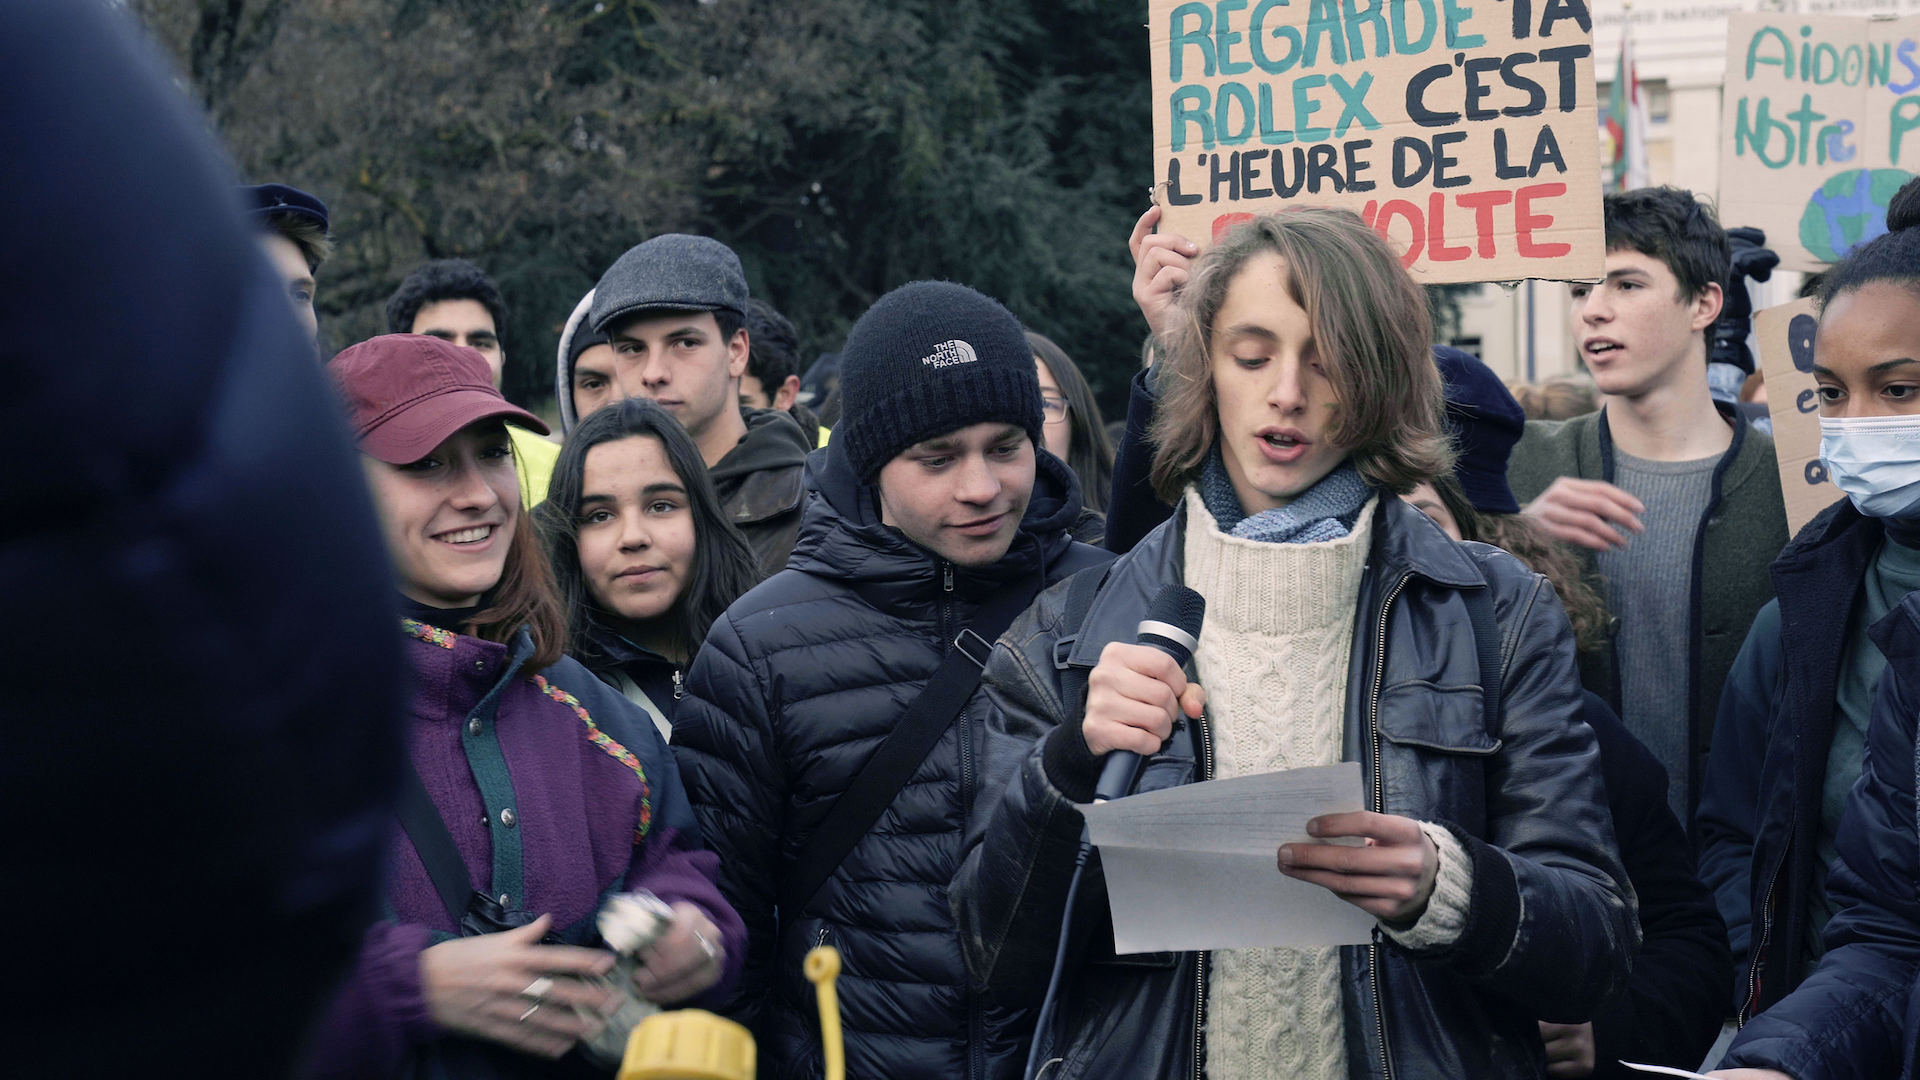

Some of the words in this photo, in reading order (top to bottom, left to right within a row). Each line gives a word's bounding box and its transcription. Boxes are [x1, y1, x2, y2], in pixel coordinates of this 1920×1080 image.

[1170, 0, 1487, 83] REGARDE
[1170, 71, 1384, 152] ROLEX
[1406, 44, 1591, 127] C'EST
[1168, 139, 1375, 206] L'HEURE
[1393, 131, 1472, 189] DE
[1494, 124, 1568, 179] LA
[921, 349, 957, 365] NORTH
[933, 340, 955, 352] THE
[933, 355, 960, 369] FACE
